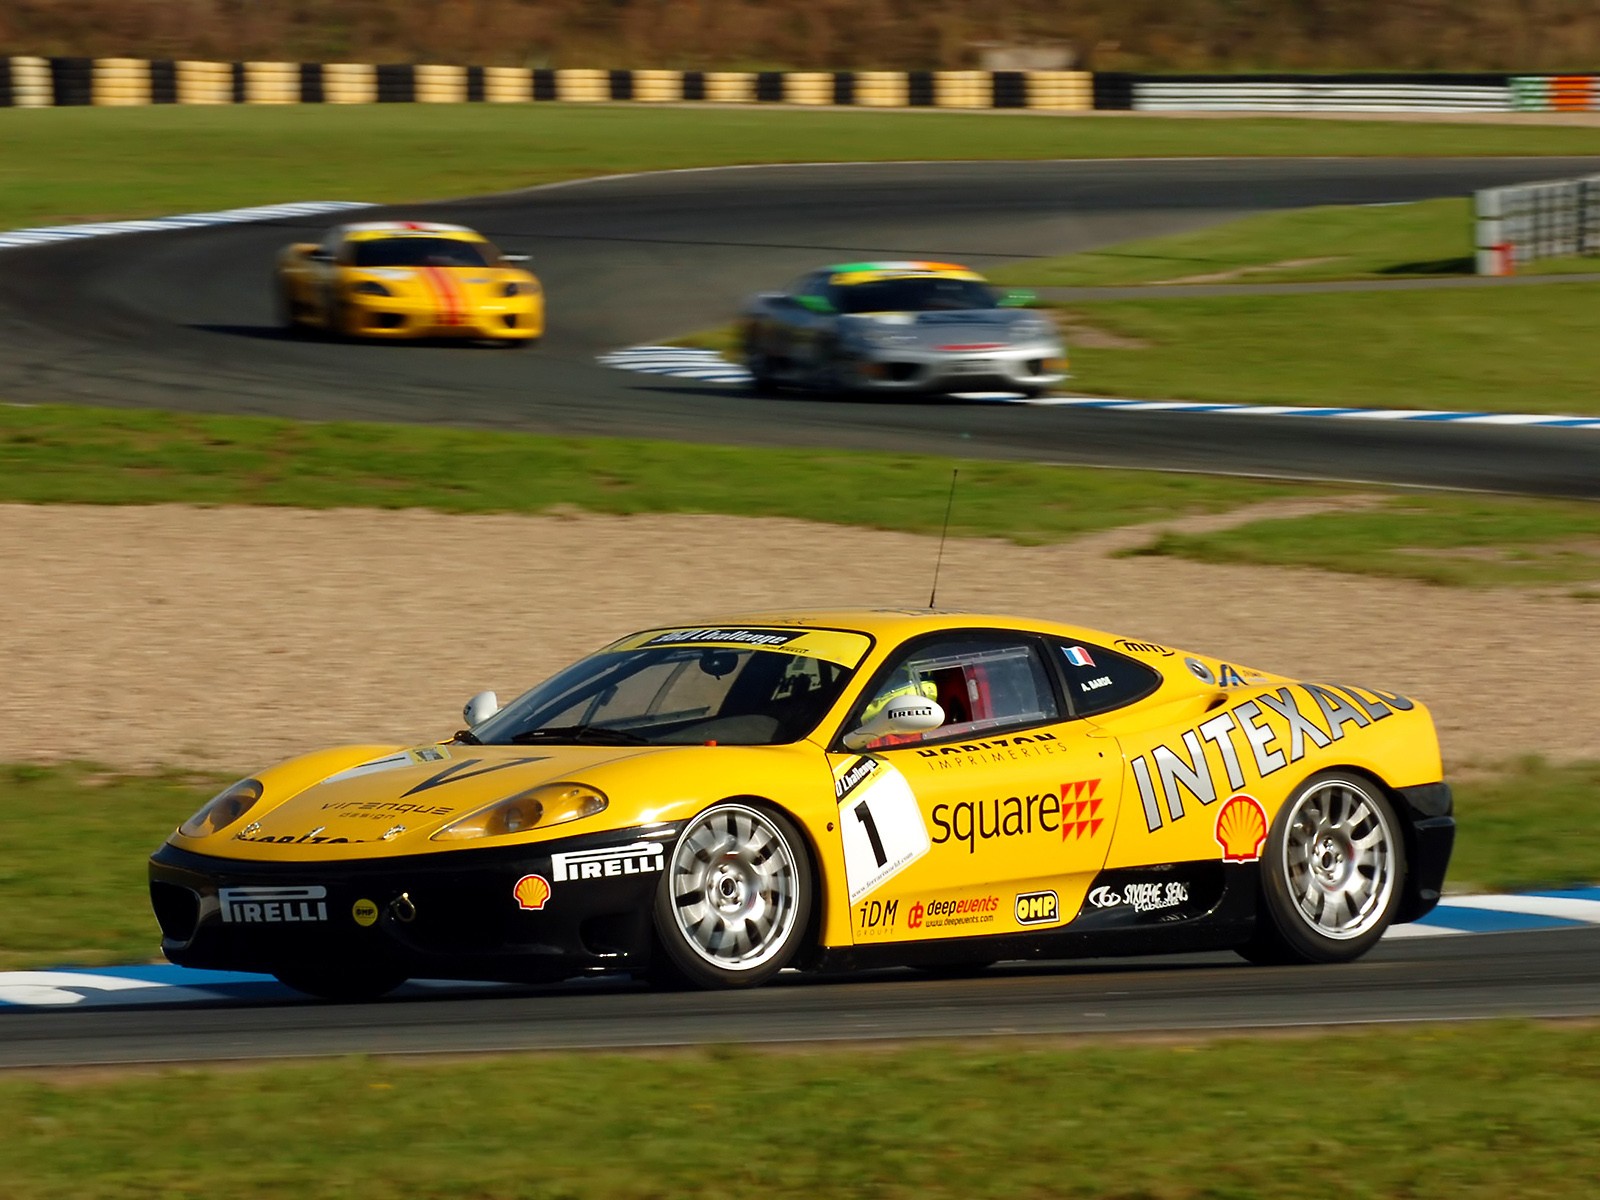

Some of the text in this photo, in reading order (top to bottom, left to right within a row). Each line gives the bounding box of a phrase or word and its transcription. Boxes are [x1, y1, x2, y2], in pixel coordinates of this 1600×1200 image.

[693, 629, 788, 645] Challenge
[888, 706, 932, 719] PIRELLI
[928, 743, 1068, 771] IMPRIMERIES
[854, 800, 888, 868] 1
[932, 793, 1060, 854] square
[551, 843, 664, 882] PIRELLI
[218, 885, 328, 922] PIRELLI
[927, 895, 999, 917] deepevents
[1017, 896, 1055, 920] OMP
[857, 927, 895, 938] GROUPE
[925, 914, 994, 928] www.deepevents.com
